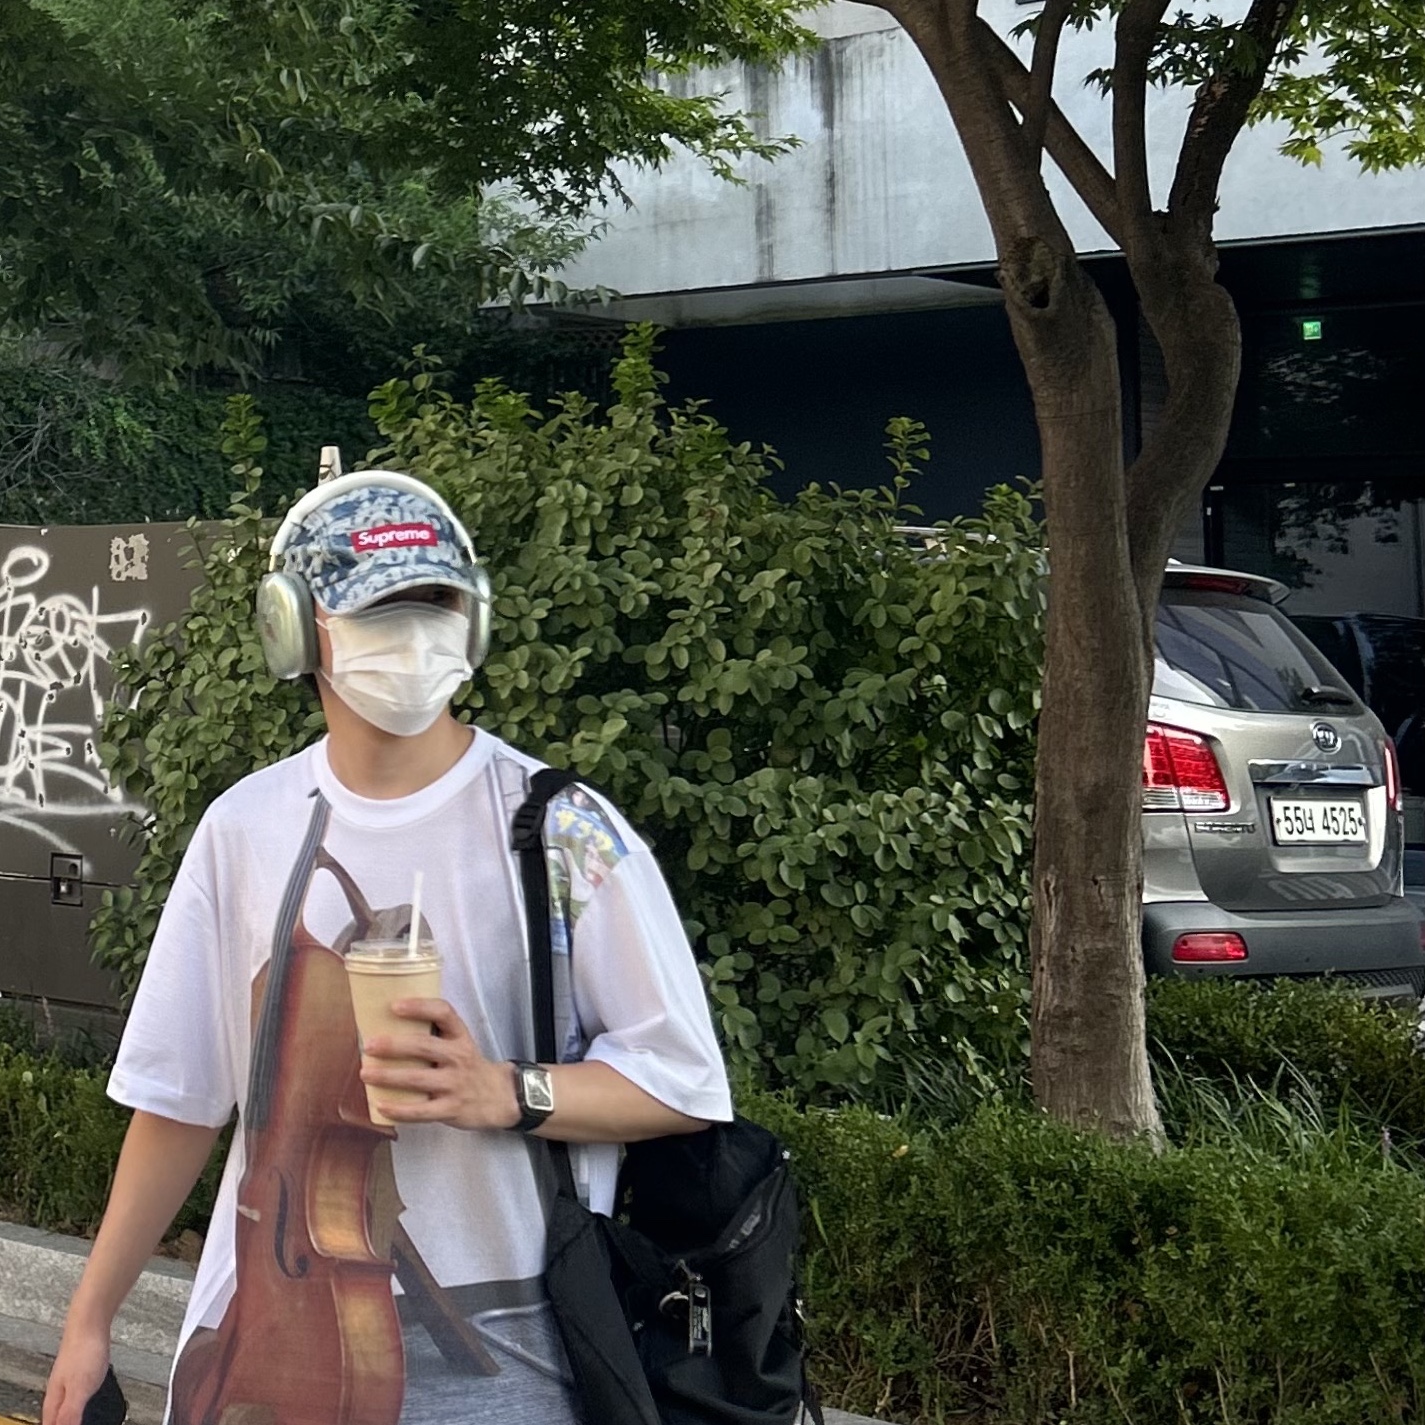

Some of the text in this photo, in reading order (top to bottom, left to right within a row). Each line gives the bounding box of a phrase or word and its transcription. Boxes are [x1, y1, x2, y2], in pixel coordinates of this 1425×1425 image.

[358, 528, 431, 547] Supreme
[1283, 806, 1358, 836] 55너 4525
